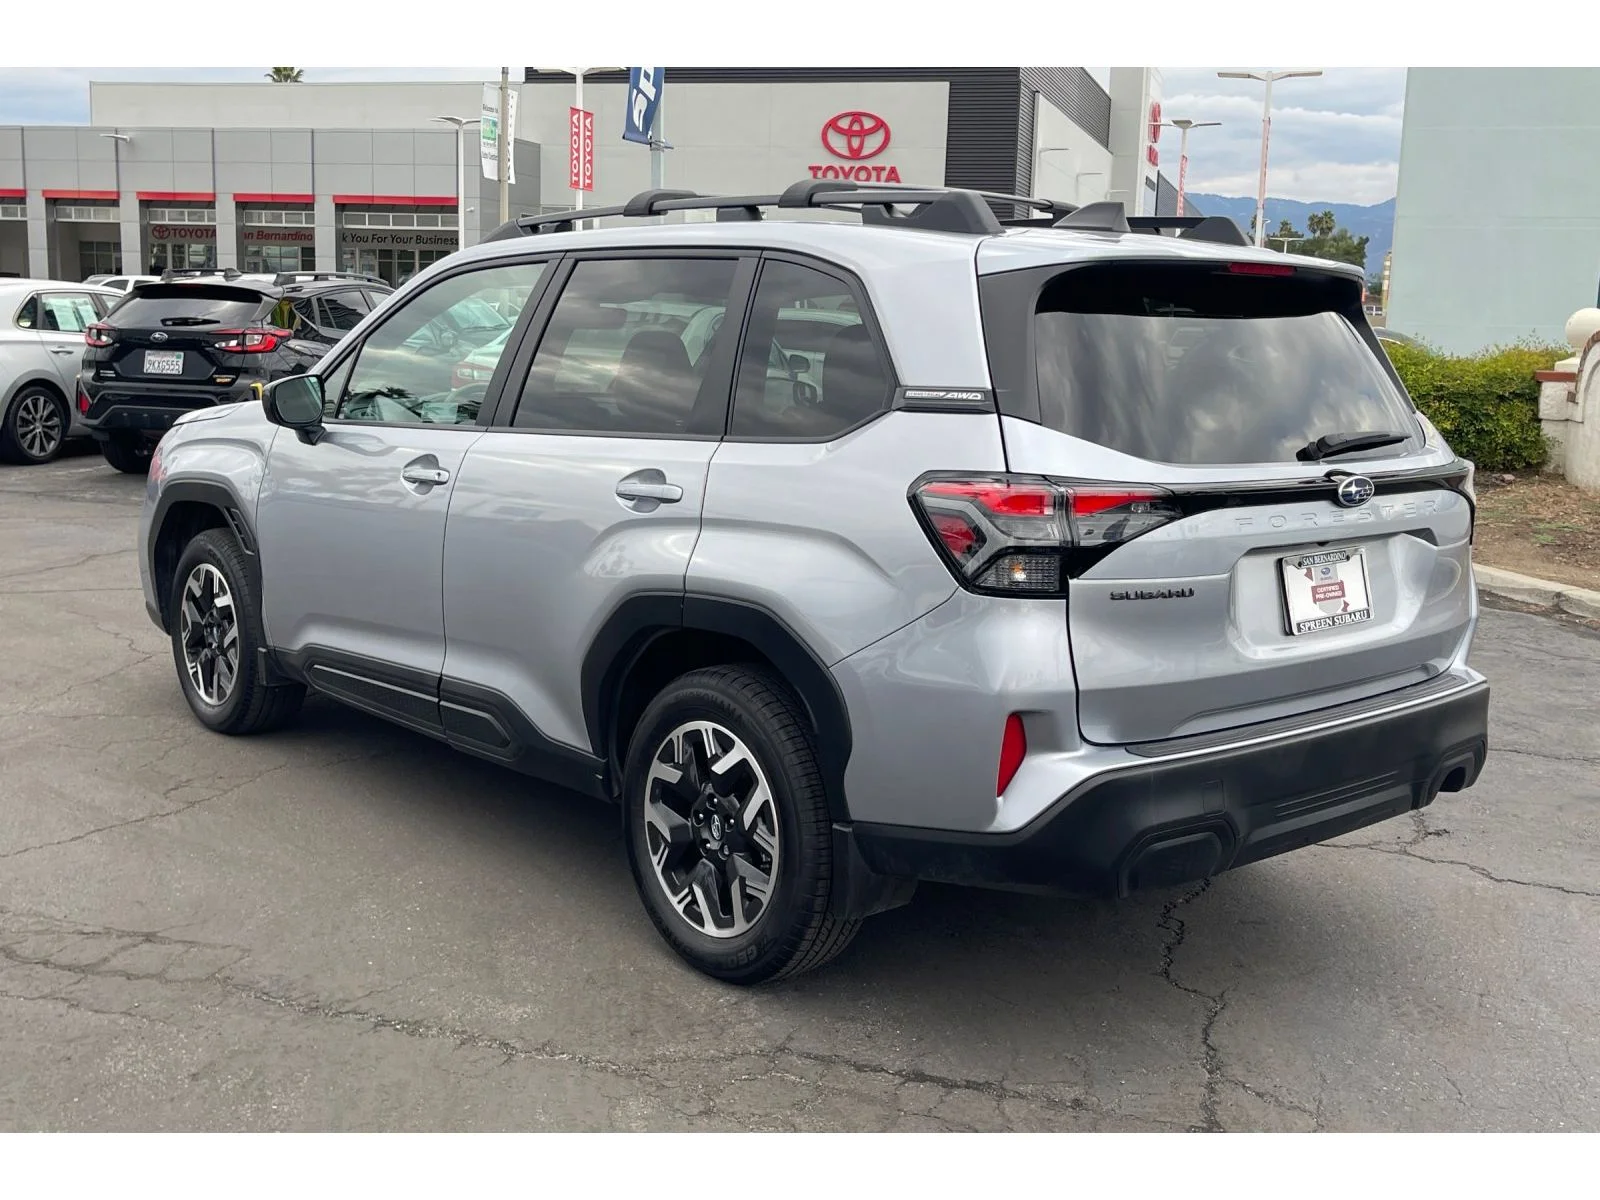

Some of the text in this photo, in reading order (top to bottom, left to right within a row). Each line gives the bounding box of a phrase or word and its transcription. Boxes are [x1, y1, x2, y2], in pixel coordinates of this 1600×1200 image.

[571, 113, 580, 184] TOYOTA
[584, 116, 592, 187] TOYOTA
[808, 165, 902, 183] TOYOTA
[170, 227, 217, 239] TOYOTA
[256, 230, 313, 241] Bernardino
[350, 233, 369, 243] You
[371, 234, 388, 243] For
[390, 234, 413, 245] Your
[415, 235, 459, 245] Business
[943, 392, 982, 400] AWD
[1235, 499, 1438, 530] FORESTER
[1303, 551, 1346, 565] SAN BERNARDINO
[1110, 587, 1195, 600] SUBARU
[1300, 610, 1367, 632] SPREEN SUBARU
